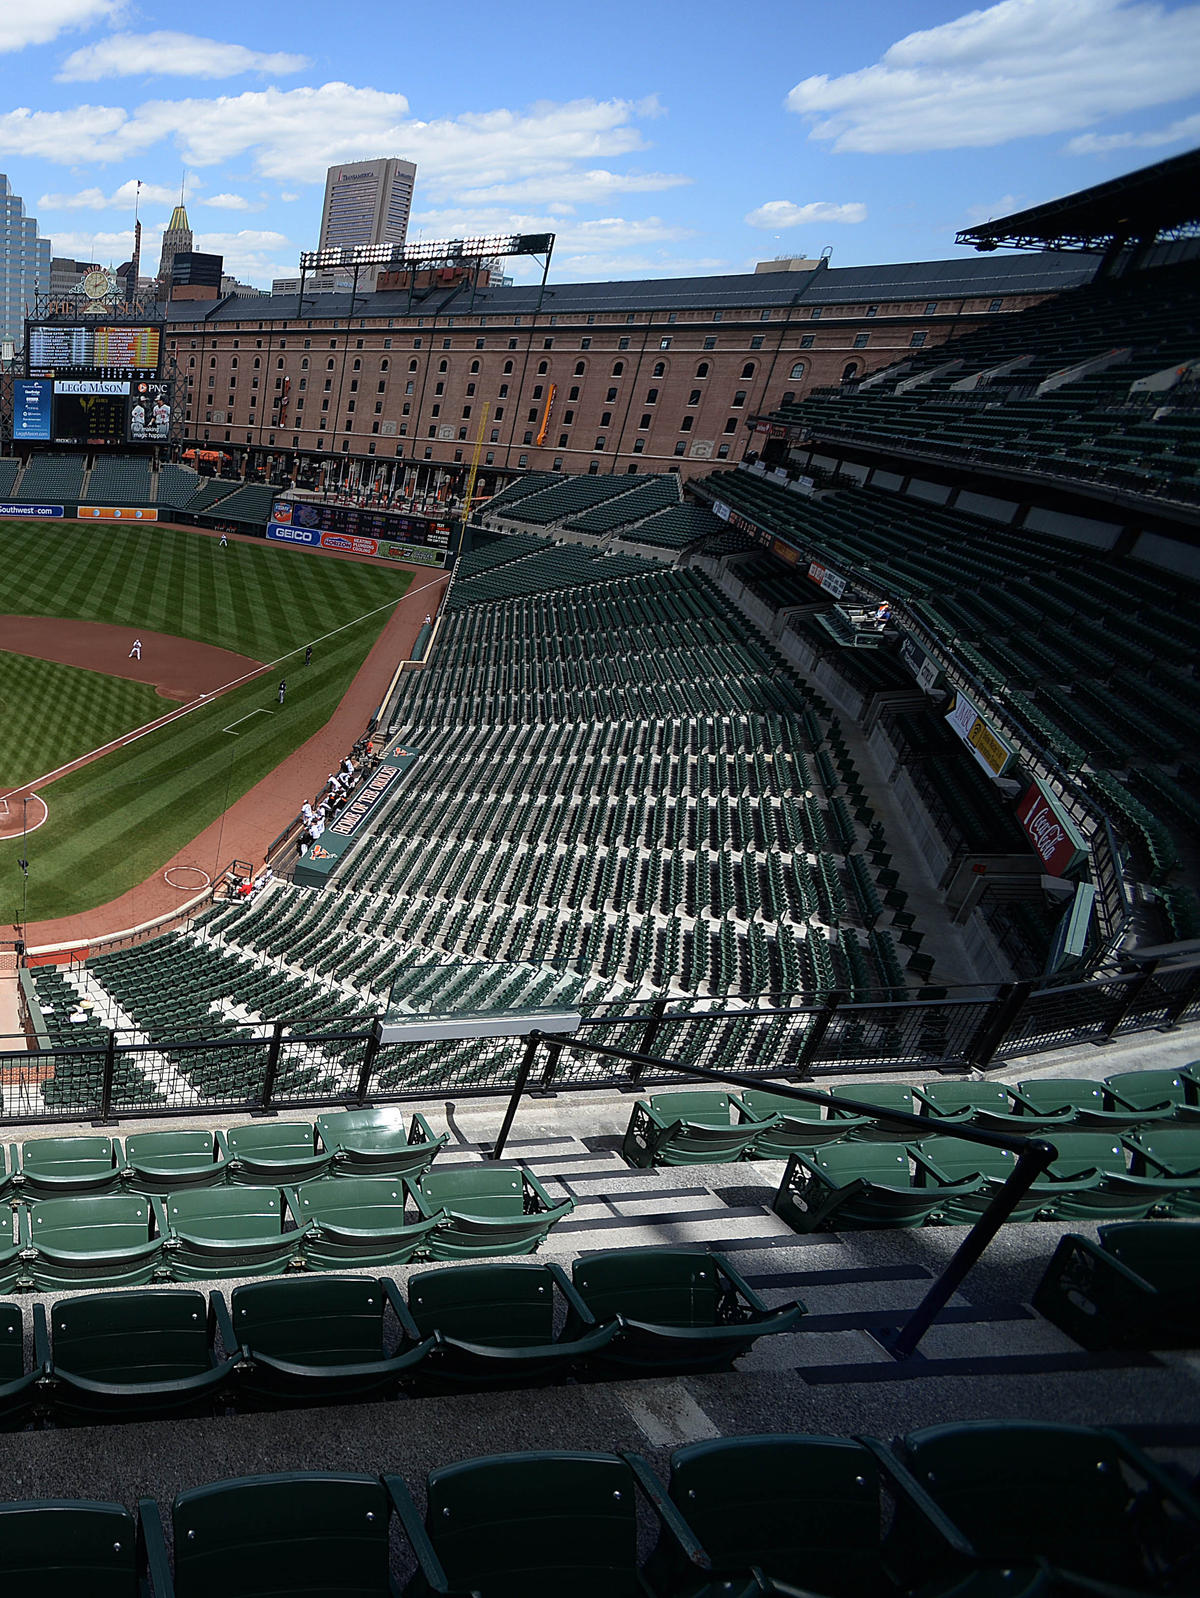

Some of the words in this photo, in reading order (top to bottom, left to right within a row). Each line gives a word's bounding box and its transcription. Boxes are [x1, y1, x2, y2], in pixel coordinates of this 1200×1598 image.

[117, 301, 145, 315] SUN
[60, 382, 88, 393] LEGG
[89, 382, 124, 393] MASON
[148, 384, 168, 393] PNC
[275, 527, 313, 542] GEICO
[324, 539, 353, 549] HORIZON
[369, 766, 398, 791] ORIOLES
[361, 788, 380, 804] THE
[351, 800, 369, 814] OF
[332, 811, 362, 835] HOME
